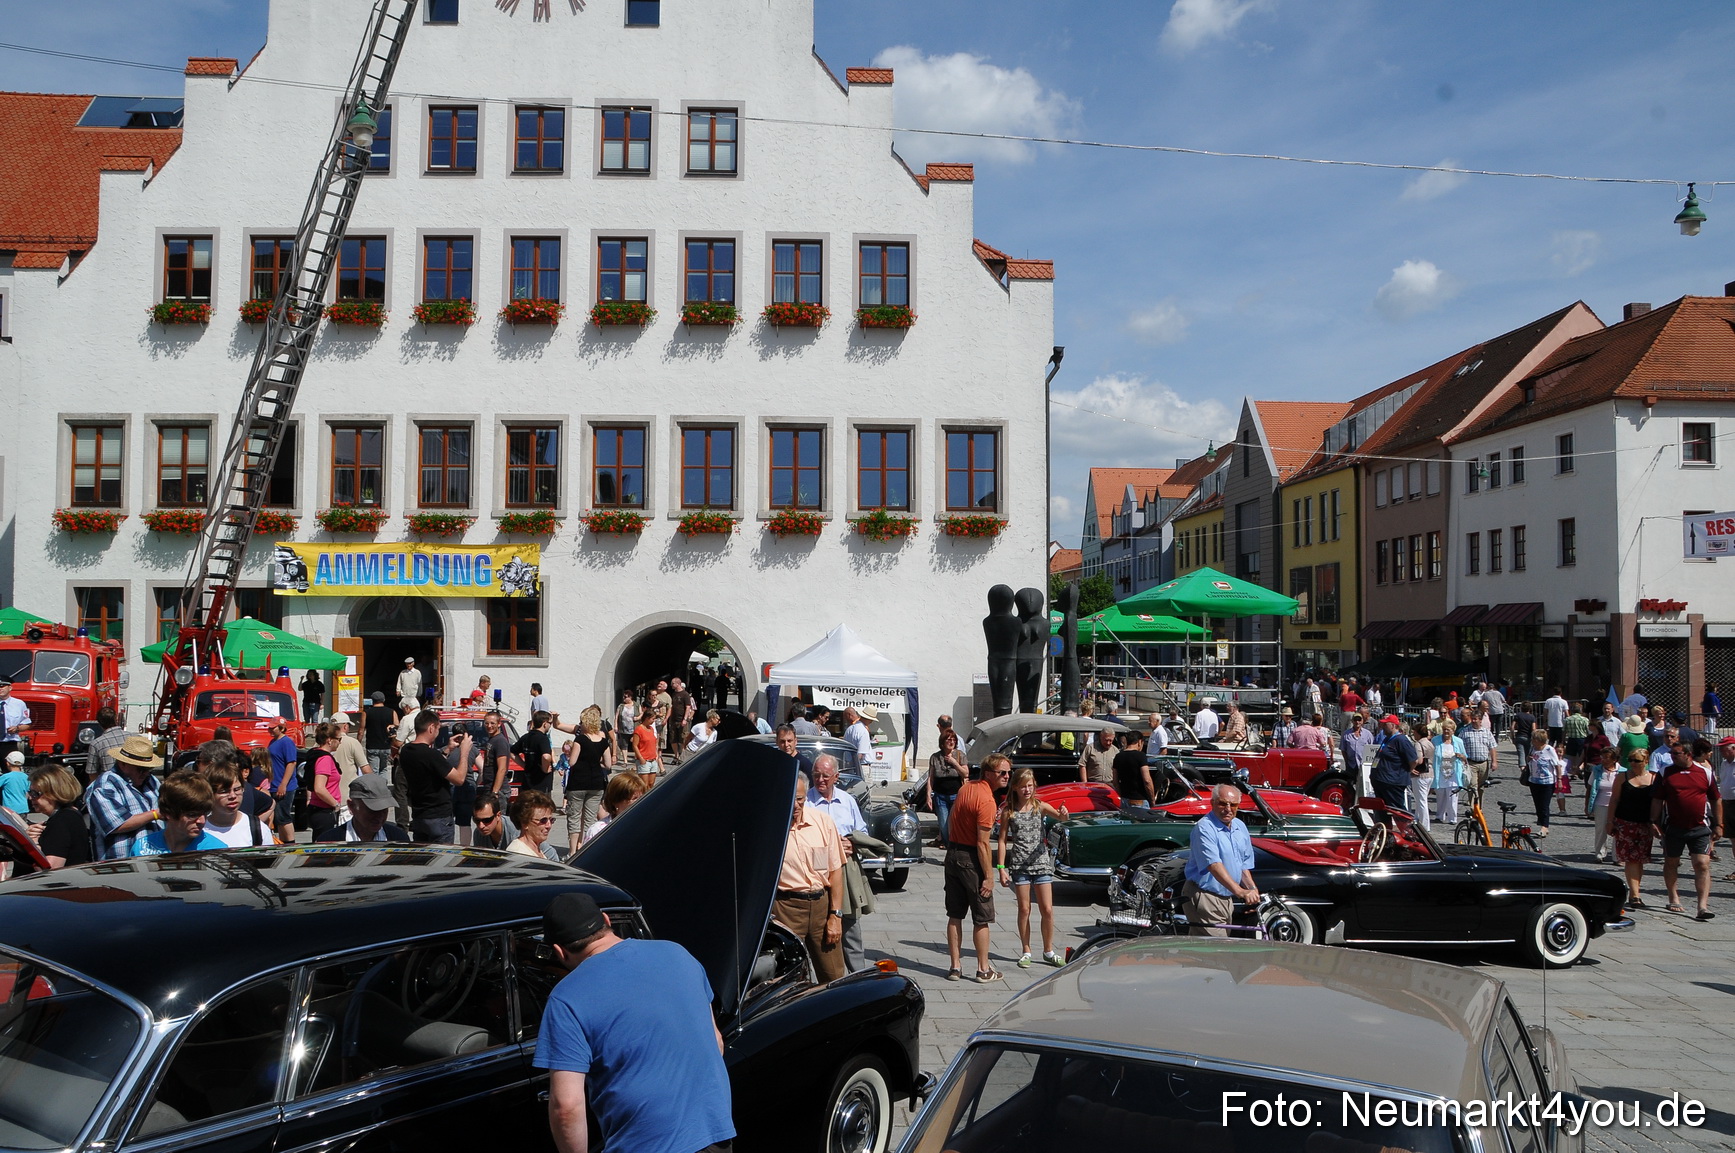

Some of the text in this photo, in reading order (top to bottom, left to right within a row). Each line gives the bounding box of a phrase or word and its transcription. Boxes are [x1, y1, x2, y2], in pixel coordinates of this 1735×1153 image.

[313, 552, 493, 588] ANMELDUNG
[1640, 598, 1688, 615] Döpfer
[818, 686, 906, 696] Vorangemeldete
[832, 698, 891, 709] Teilnehmer
